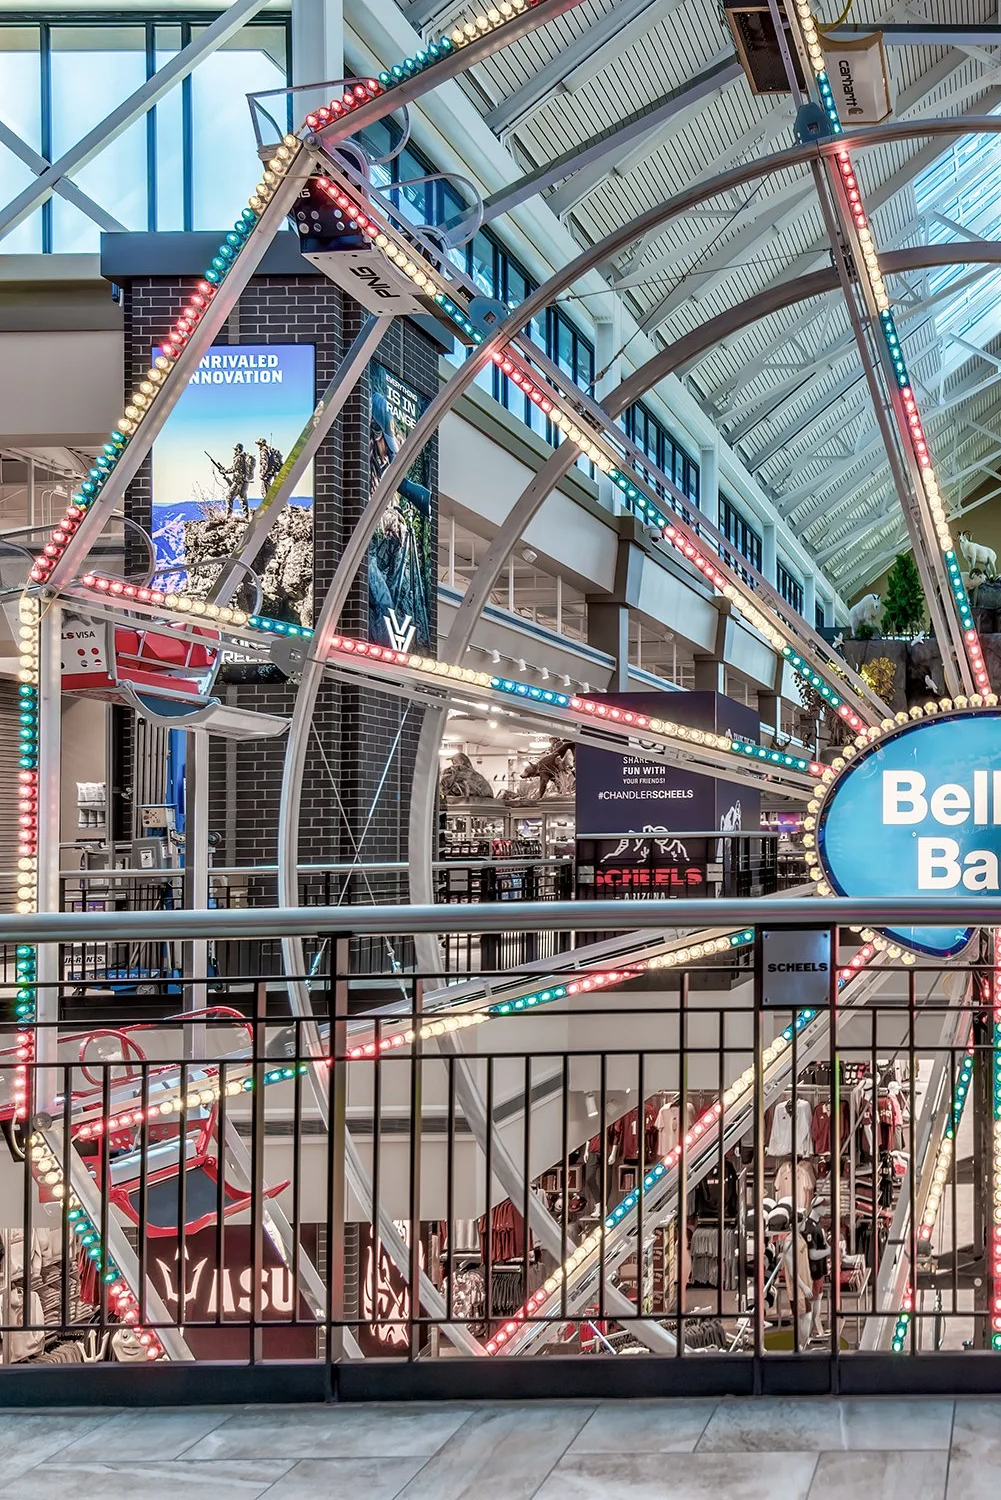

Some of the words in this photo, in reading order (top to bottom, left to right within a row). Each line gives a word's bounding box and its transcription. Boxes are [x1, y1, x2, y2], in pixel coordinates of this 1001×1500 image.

[838, 59, 859, 107] carhartt
[348, 265, 401, 299] PING
[200, 354, 279, 369] NRIVALED
[189, 369, 283, 385] NNOVATION
[386, 385, 401, 406] IS
[402, 396, 416, 417] IN
[386, 401, 417, 430] RANGE
[75, 630, 96, 639] VISA
[623, 767, 641, 775] FUN
[643, 766, 666, 774] WITH
[598, 789, 694, 800] #CHANDLERSCHEELS
[767, 962, 829, 973] SCHEELS
[207, 1267, 293, 1313] ASU
